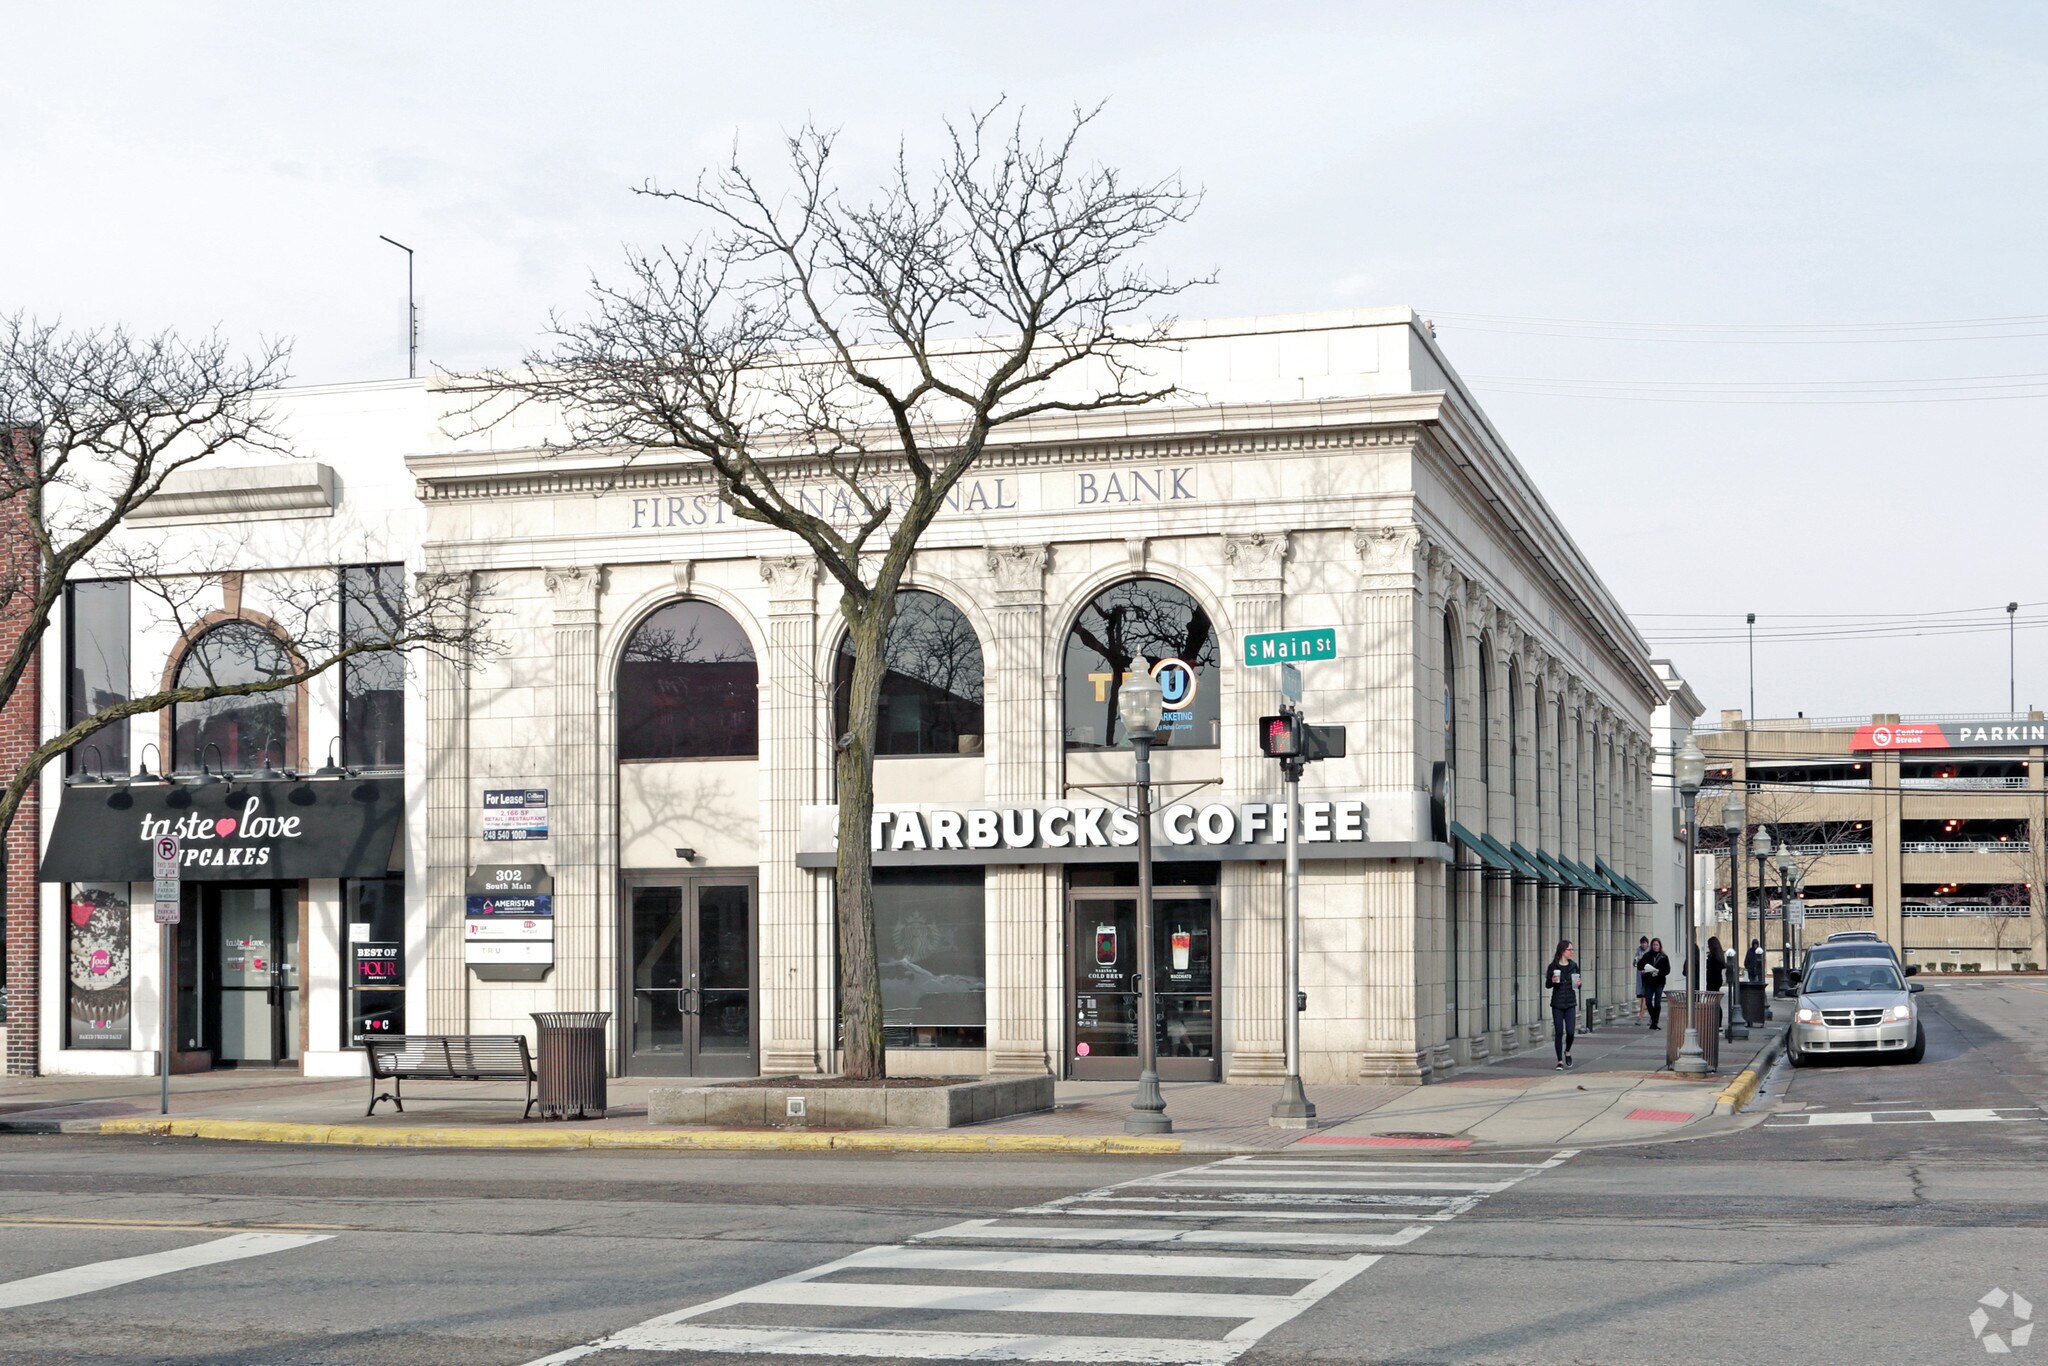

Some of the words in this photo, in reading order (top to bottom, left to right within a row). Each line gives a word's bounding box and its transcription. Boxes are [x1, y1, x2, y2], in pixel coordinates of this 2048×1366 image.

[632, 496, 725, 528] FIRST
[1078, 467, 1196, 504] BANK
[1249, 643, 1257, 657] S
[1262, 638, 1311, 659] Main
[1316, 638, 1331, 652] St
[1088, 670, 1185, 702] TU
[1157, 711, 1193, 721] ARKETING
[1960, 726, 2045, 742] PARKIN
[486, 794, 499, 804] For
[500, 793, 523, 804] Lease
[141, 812, 216, 841] taste
[239, 796, 302, 838] love
[832, 806, 1139, 850] TARBUCKS
[1163, 801, 1364, 845] COFFEE
[484, 831, 497, 840] 248
[498, 831, 510, 840] 540
[511, 830, 527, 840] 1000
[178, 847, 270, 867] PCAKES
[496, 870, 522, 881] 302
[357, 948, 383, 957] BEST
[384, 948, 397, 957] OF
[91, 954, 110, 969] food
[358, 961, 396, 975] HOUR
[90, 1020, 96, 1029] T
[105, 1019, 112, 1029] C
[365, 1020, 371, 1030] T
[382, 1020, 389, 1030] C
